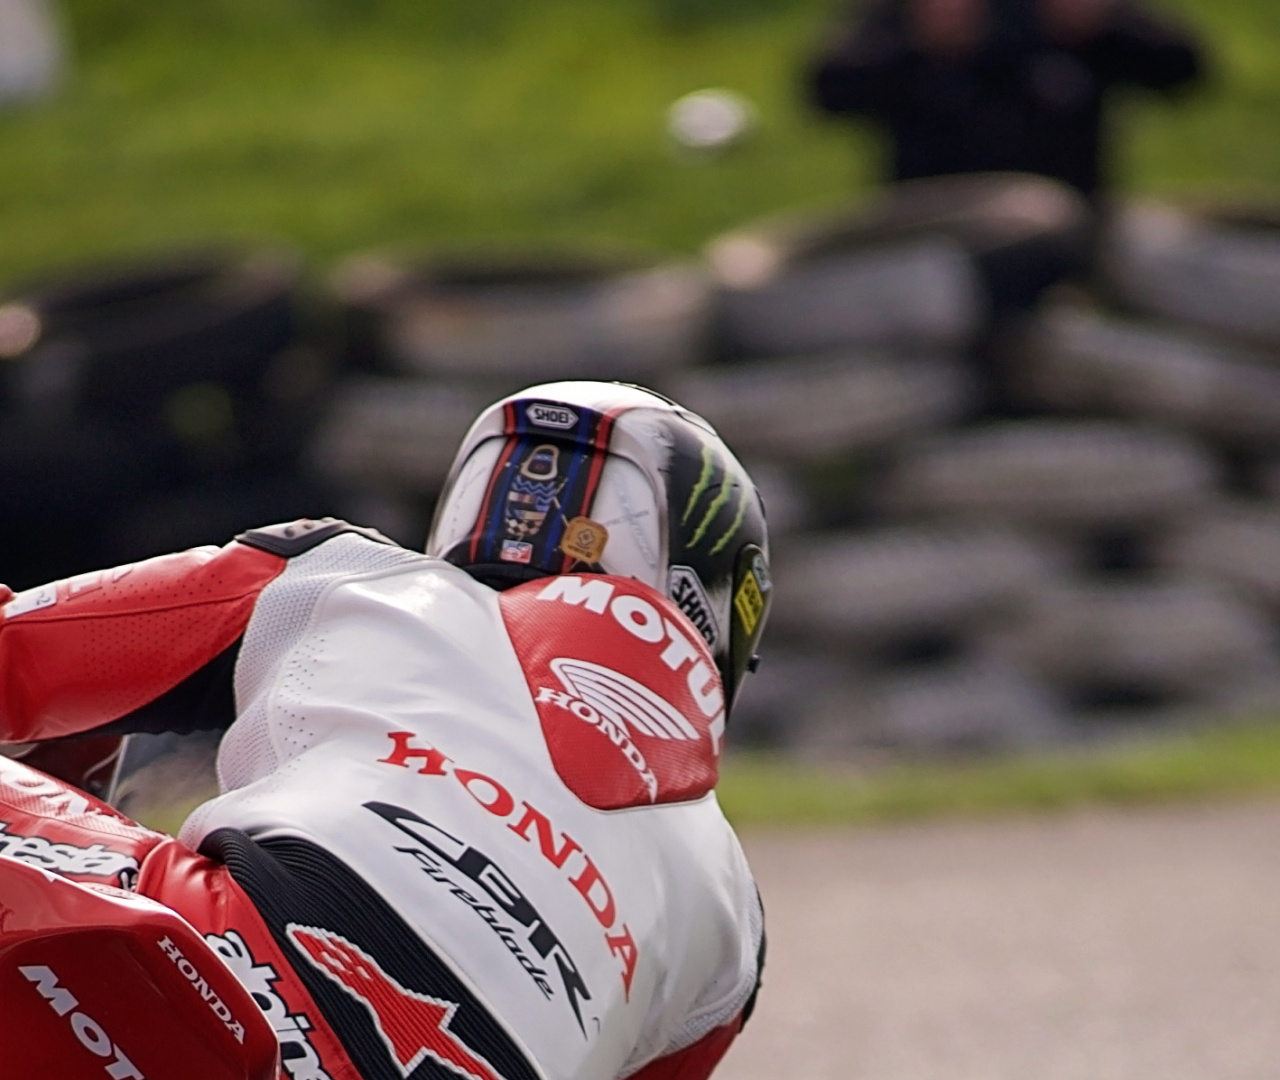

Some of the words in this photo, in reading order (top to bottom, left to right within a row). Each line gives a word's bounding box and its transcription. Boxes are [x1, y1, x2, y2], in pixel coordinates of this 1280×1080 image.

[535, 408, 569, 424] SHOEI
[533, 686, 659, 804] HONDA
[536, 576, 727, 757] MOTUL
[361, 800, 592, 1043] CBR
[377, 731, 639, 1004] HONDA
[393, 845, 555, 1002] Fireblade
[156, 934, 246, 1046] HONDA
